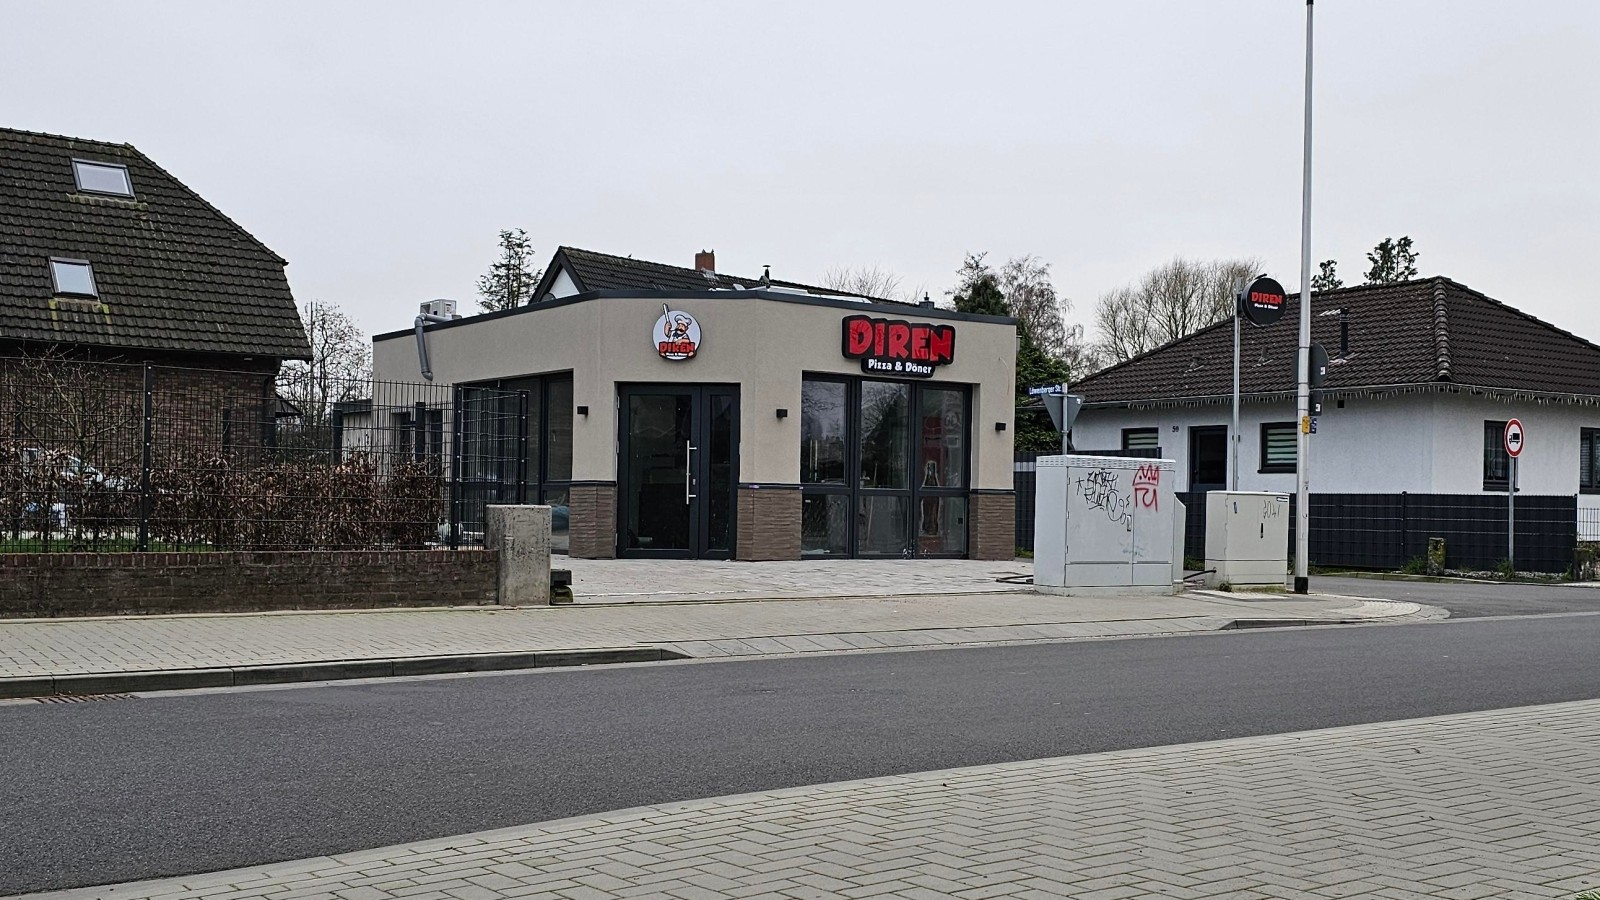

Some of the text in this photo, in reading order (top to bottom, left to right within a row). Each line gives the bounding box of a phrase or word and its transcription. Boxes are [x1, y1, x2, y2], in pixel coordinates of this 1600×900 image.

[1251, 291, 1282, 304] DIREN
[849, 319, 952, 361] DIREN
[868, 359, 932, 374] Pizza & Döner
